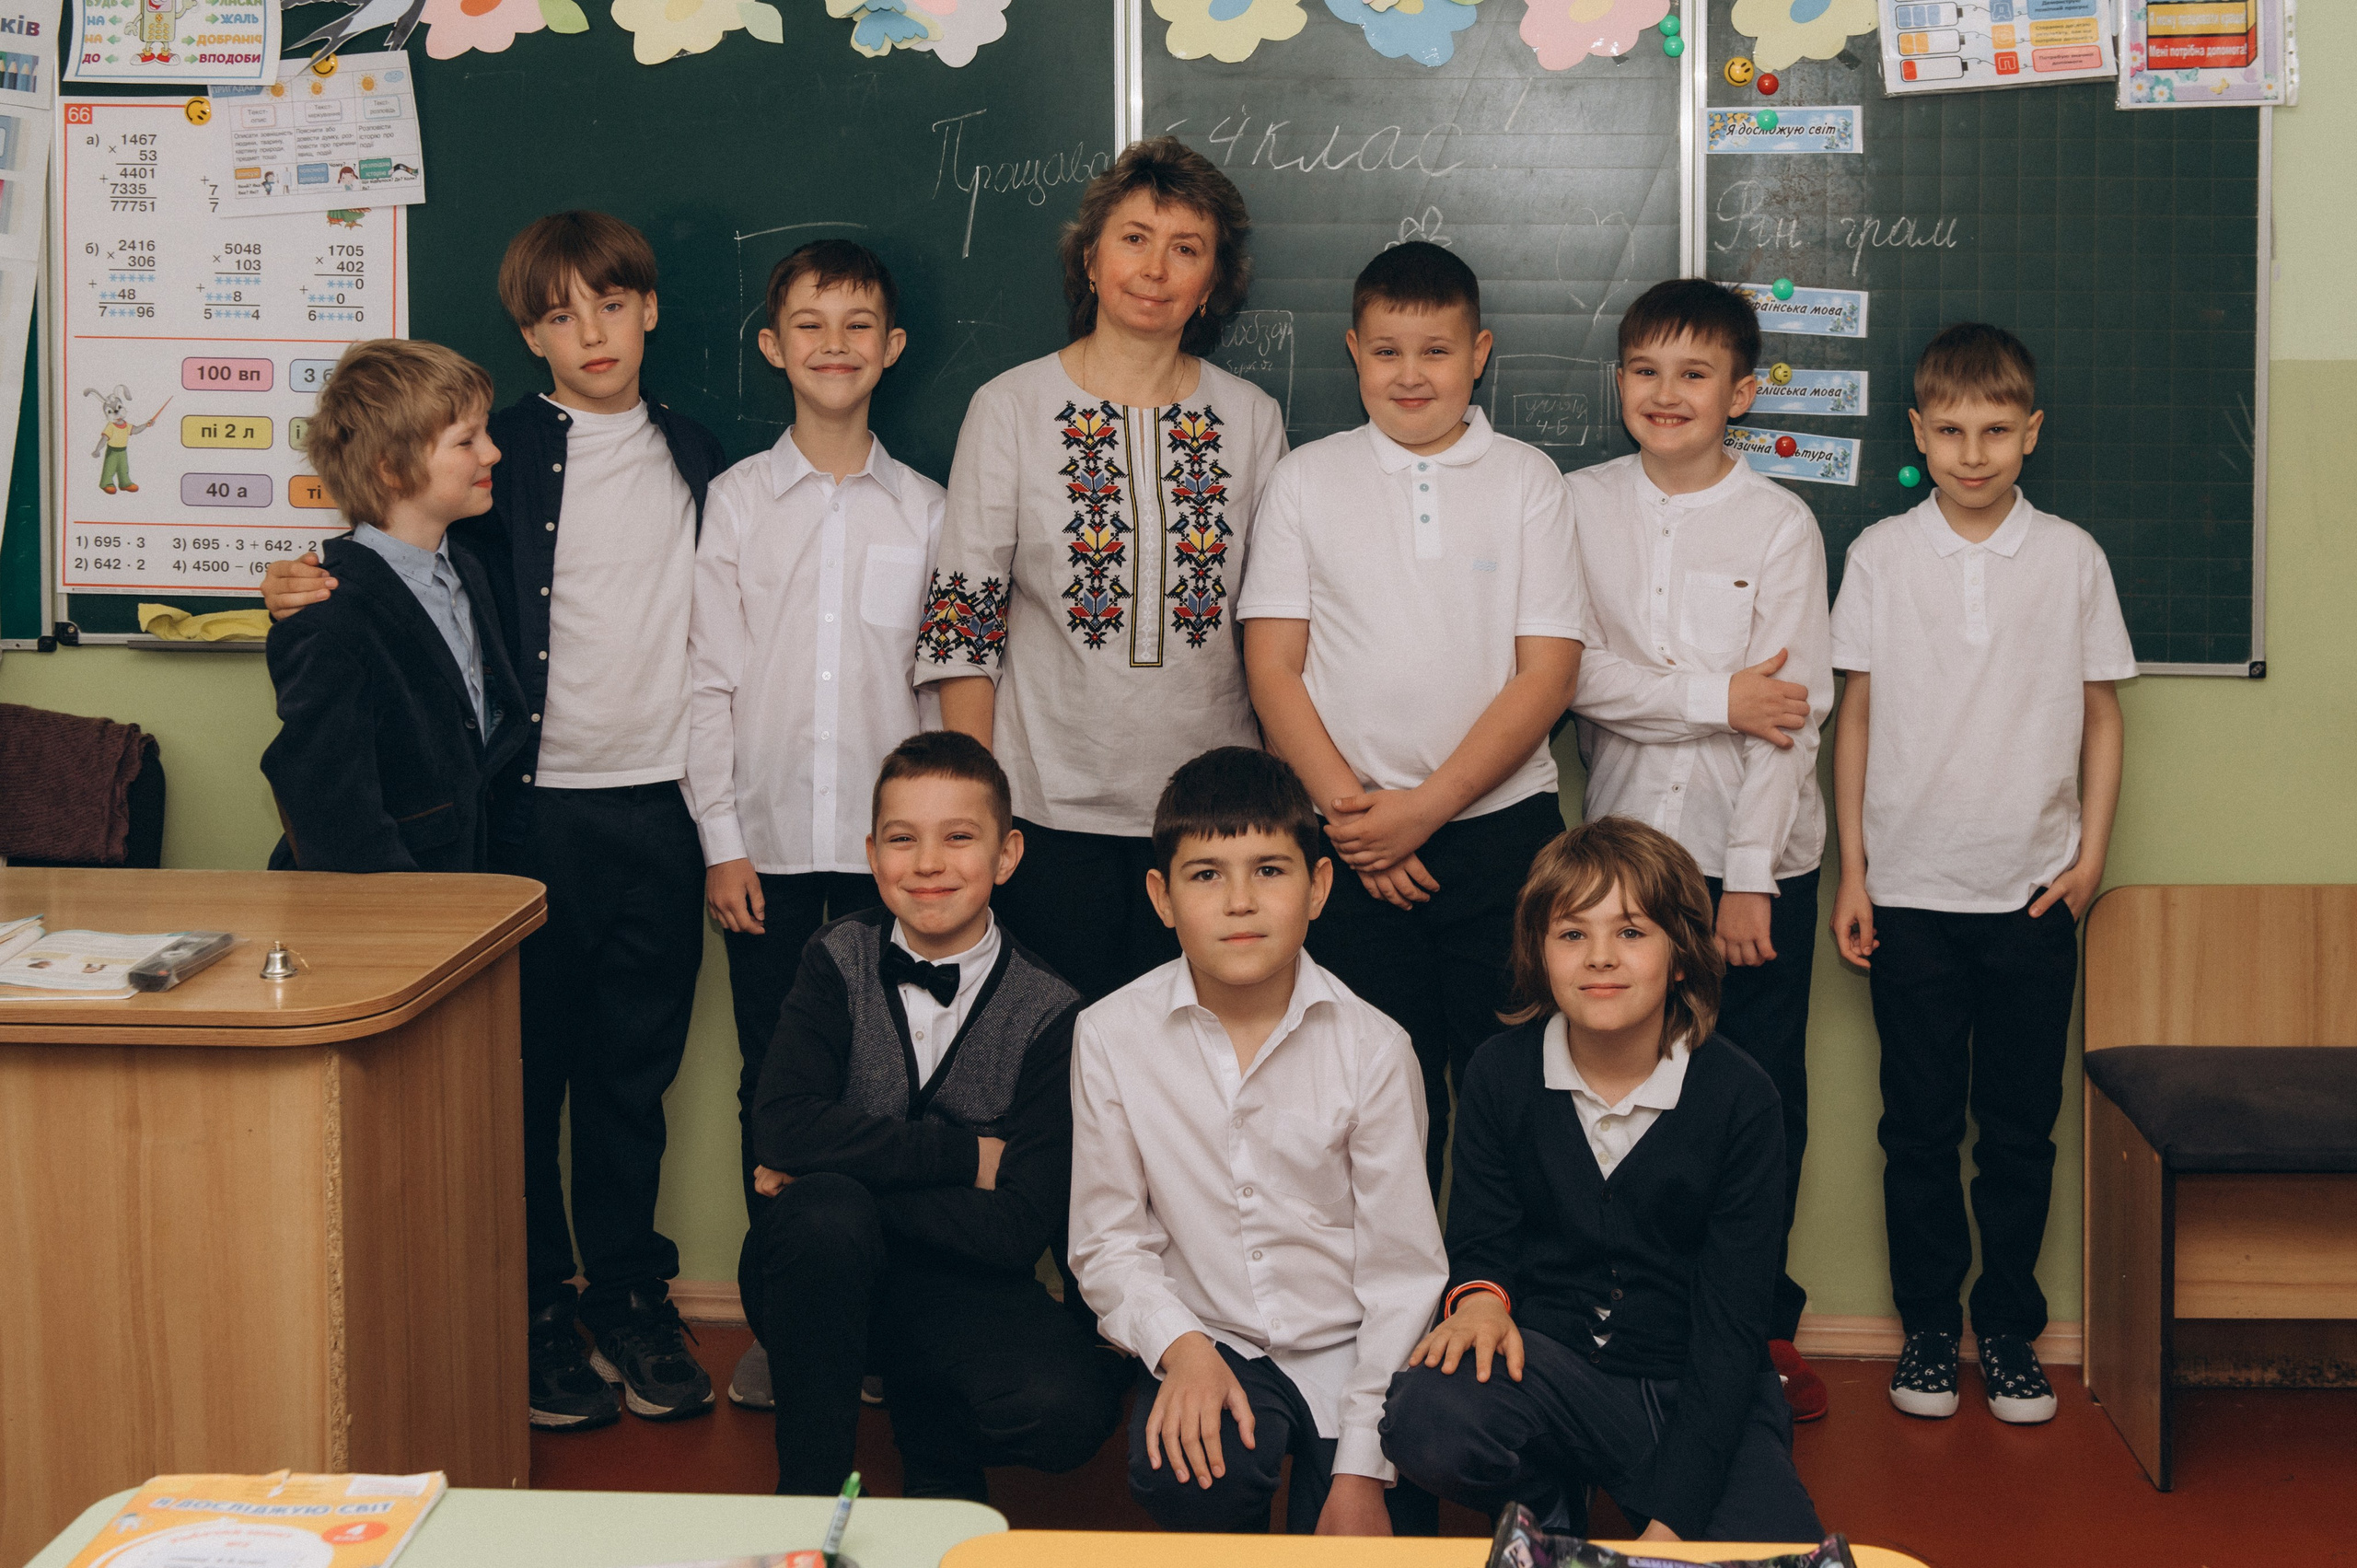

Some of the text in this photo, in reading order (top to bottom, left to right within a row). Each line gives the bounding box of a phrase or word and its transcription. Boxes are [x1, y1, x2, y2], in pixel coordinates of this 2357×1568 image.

[87, 14, 259, 26] НА ЖАЛЬ
[85, 34, 262, 46] НА ДОБРАНІЧ
[2149, 45, 2169, 57] Мені
[82, 53, 261, 64] ДО ВПОДОБИ
[68, 107, 91, 122] 66
[1725, 123, 1736, 136] Я
[1808, 122, 1837, 136] світ
[121, 134, 157, 145] 1467
[139, 150, 157, 161] 53
[120, 168, 155, 179] 4401
[110, 183, 146, 194] 7335
[209, 184, 218, 195] 7
[932, 108, 1111, 260] Прощава
[110, 201, 155, 212] 77751
[209, 202, 219, 213] 7
[118, 239, 156, 251] 2416
[225, 243, 261, 255] 5048
[328, 245, 365, 256] 1705
[128, 256, 156, 267] 306
[235, 260, 261, 271] 103
[336, 261, 365, 273] 402
[1753, 299, 1843, 317] раїнська мова
[197, 366, 261, 381] 100 вп
[304, 368, 315, 383] 3
[1809, 388, 1842, 398] мова
[201, 424, 254, 438] пі 2 л
[1724, 437, 1834, 462] Фізична ьтура
[206, 482, 248, 498] 40 а
[307, 485, 321, 499] ті
[75, 536, 89, 550] 1)
[94, 536, 122, 548] 695
[136, 537, 145, 549] 3
[172, 538, 187, 552] 3)
[192, 538, 220, 551] 695
[235, 539, 245, 551] 3
[264, 540, 293, 552] 642
[308, 540, 318, 552] 2
[75, 557, 88, 572] 2)
[94, 558, 122, 570] 642
[136, 559, 145, 571] 2
[172, 560, 187, 574] 4)
[192, 560, 229, 573] 4500
